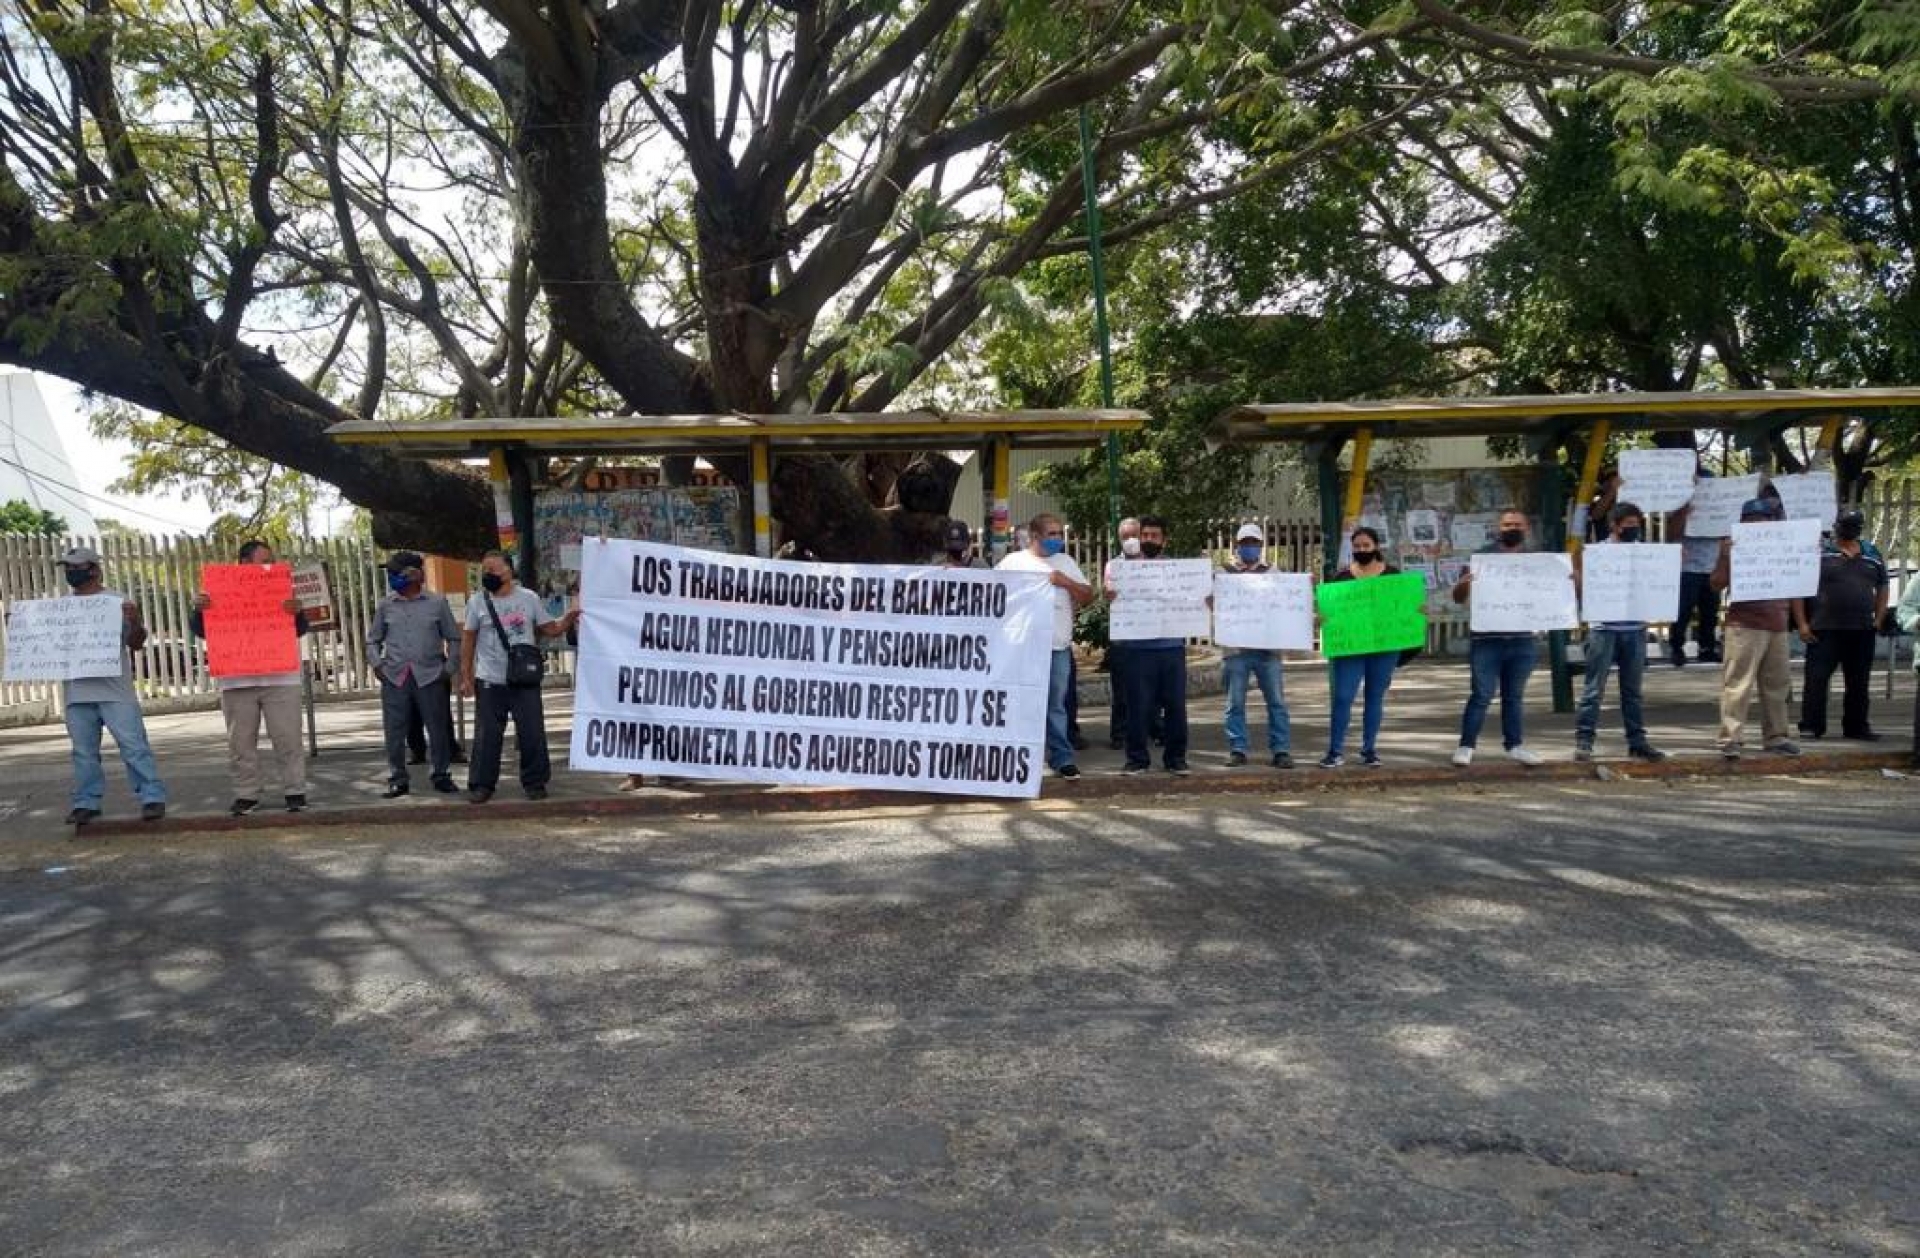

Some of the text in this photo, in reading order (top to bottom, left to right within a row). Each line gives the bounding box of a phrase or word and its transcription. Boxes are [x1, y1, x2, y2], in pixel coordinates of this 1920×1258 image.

[631, 554, 1008, 618] LOS TRABAJADORES DEL BALNEARIO
[640, 612, 991, 675] AGUA HEDIONDA Y PENSIONADOS,
[618, 665, 1008, 728] PEDIMOS AL GOBIERNO RESPETO Y SE
[586, 718, 1030, 785] COMPROMETA A LOS ACUERDOS TOMADOS
